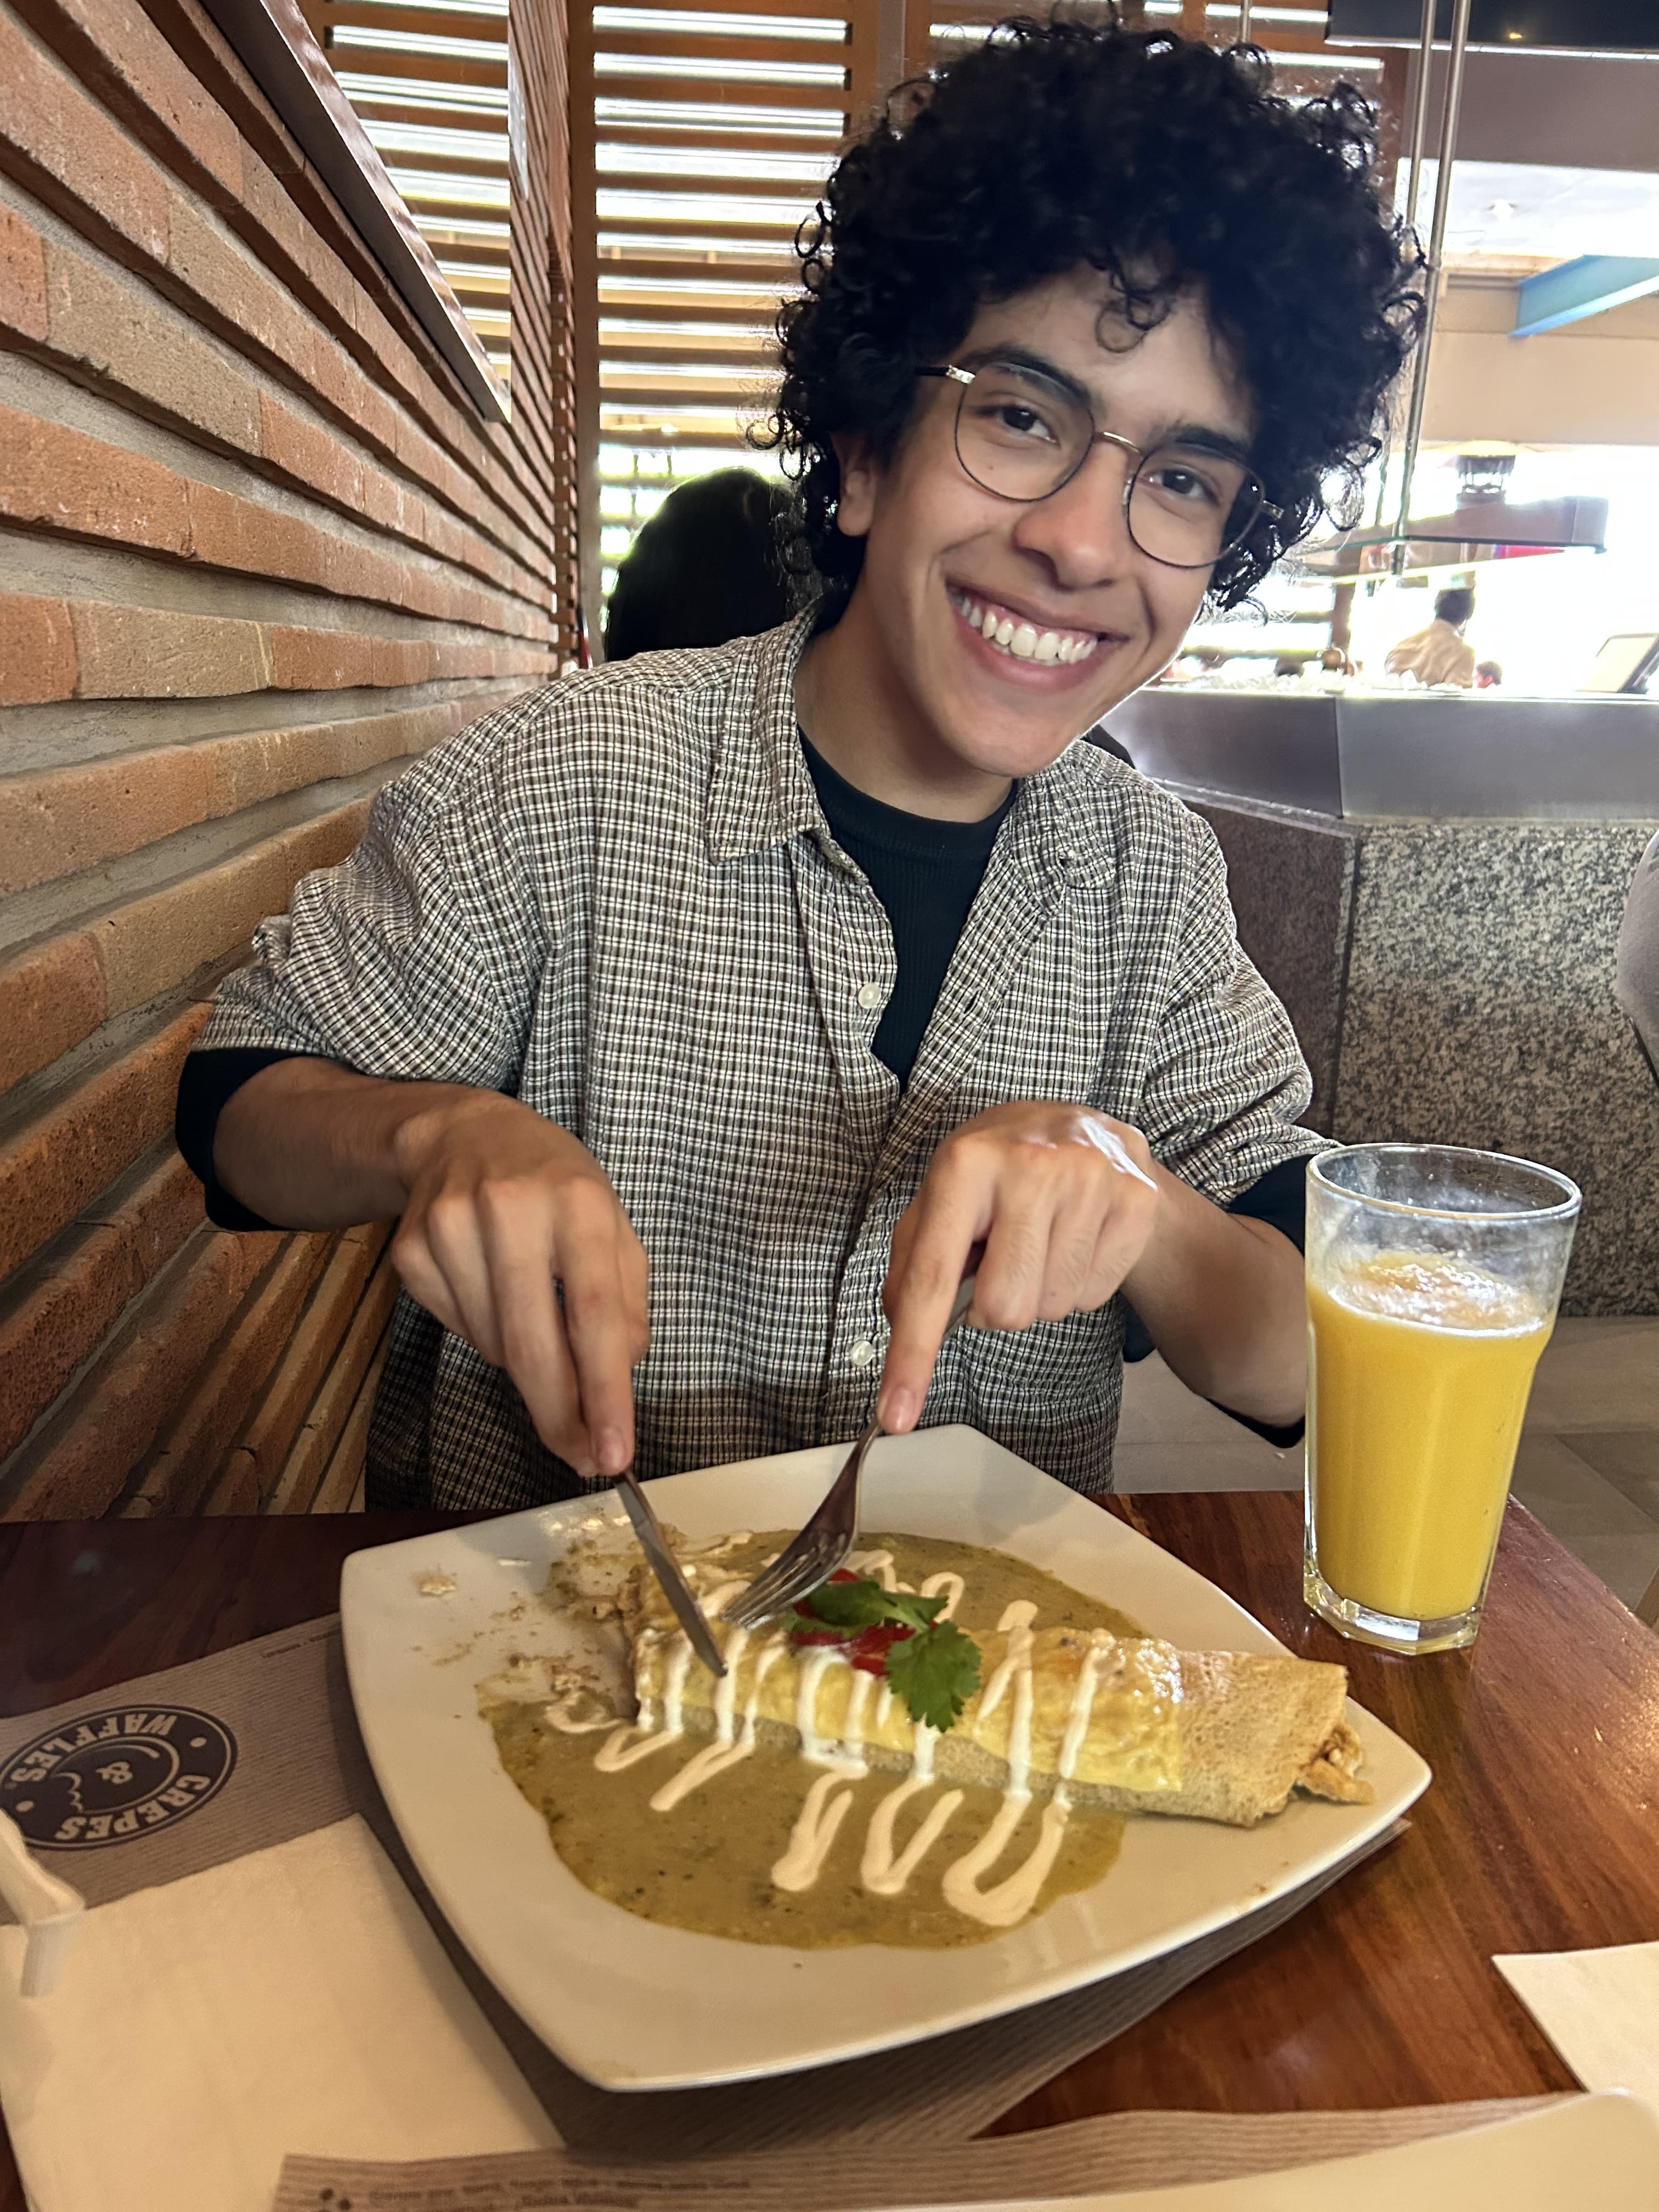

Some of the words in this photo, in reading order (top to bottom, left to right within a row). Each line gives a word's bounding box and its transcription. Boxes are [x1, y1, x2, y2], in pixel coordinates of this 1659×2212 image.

[10, 1713, 178, 1782] WAFFLES
[95, 1761, 133, 1784] &
[55, 1774, 211, 1839] CREPES
